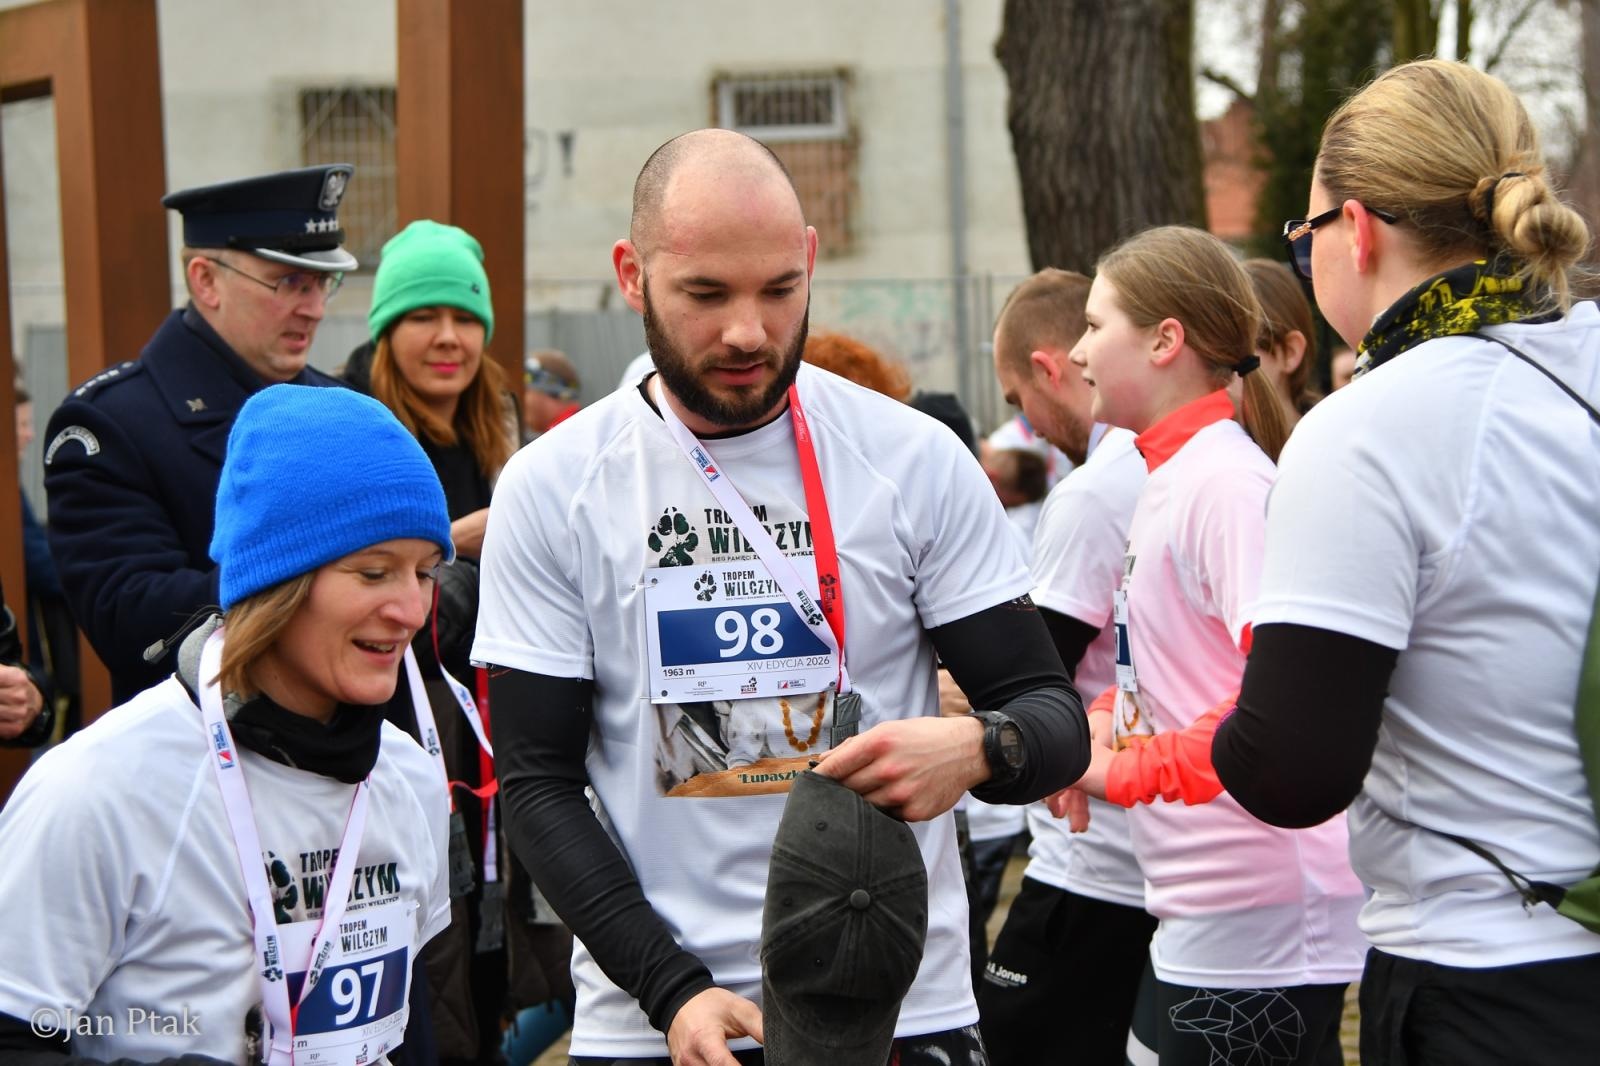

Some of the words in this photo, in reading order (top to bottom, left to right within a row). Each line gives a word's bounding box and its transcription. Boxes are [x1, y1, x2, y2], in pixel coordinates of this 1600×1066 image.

[704, 505, 767, 524] TROM
[708, 521, 813, 554] WILZY
[722, 570, 755, 581] TROPEM
[714, 607, 784, 658] 98
[663, 668, 684, 677] 1963
[747, 661, 763, 672] XIV
[766, 659, 804, 670] EDYCJA
[806, 657, 830, 667] 2026
[299, 848, 340, 873] TROPE
[339, 920, 367, 934] TROPEM
[341, 926, 388, 953] WILCZYM
[996, 965, 1028, 984] Jones
[331, 960, 384, 1026] 97
[297, 1040, 308, 1048] m
